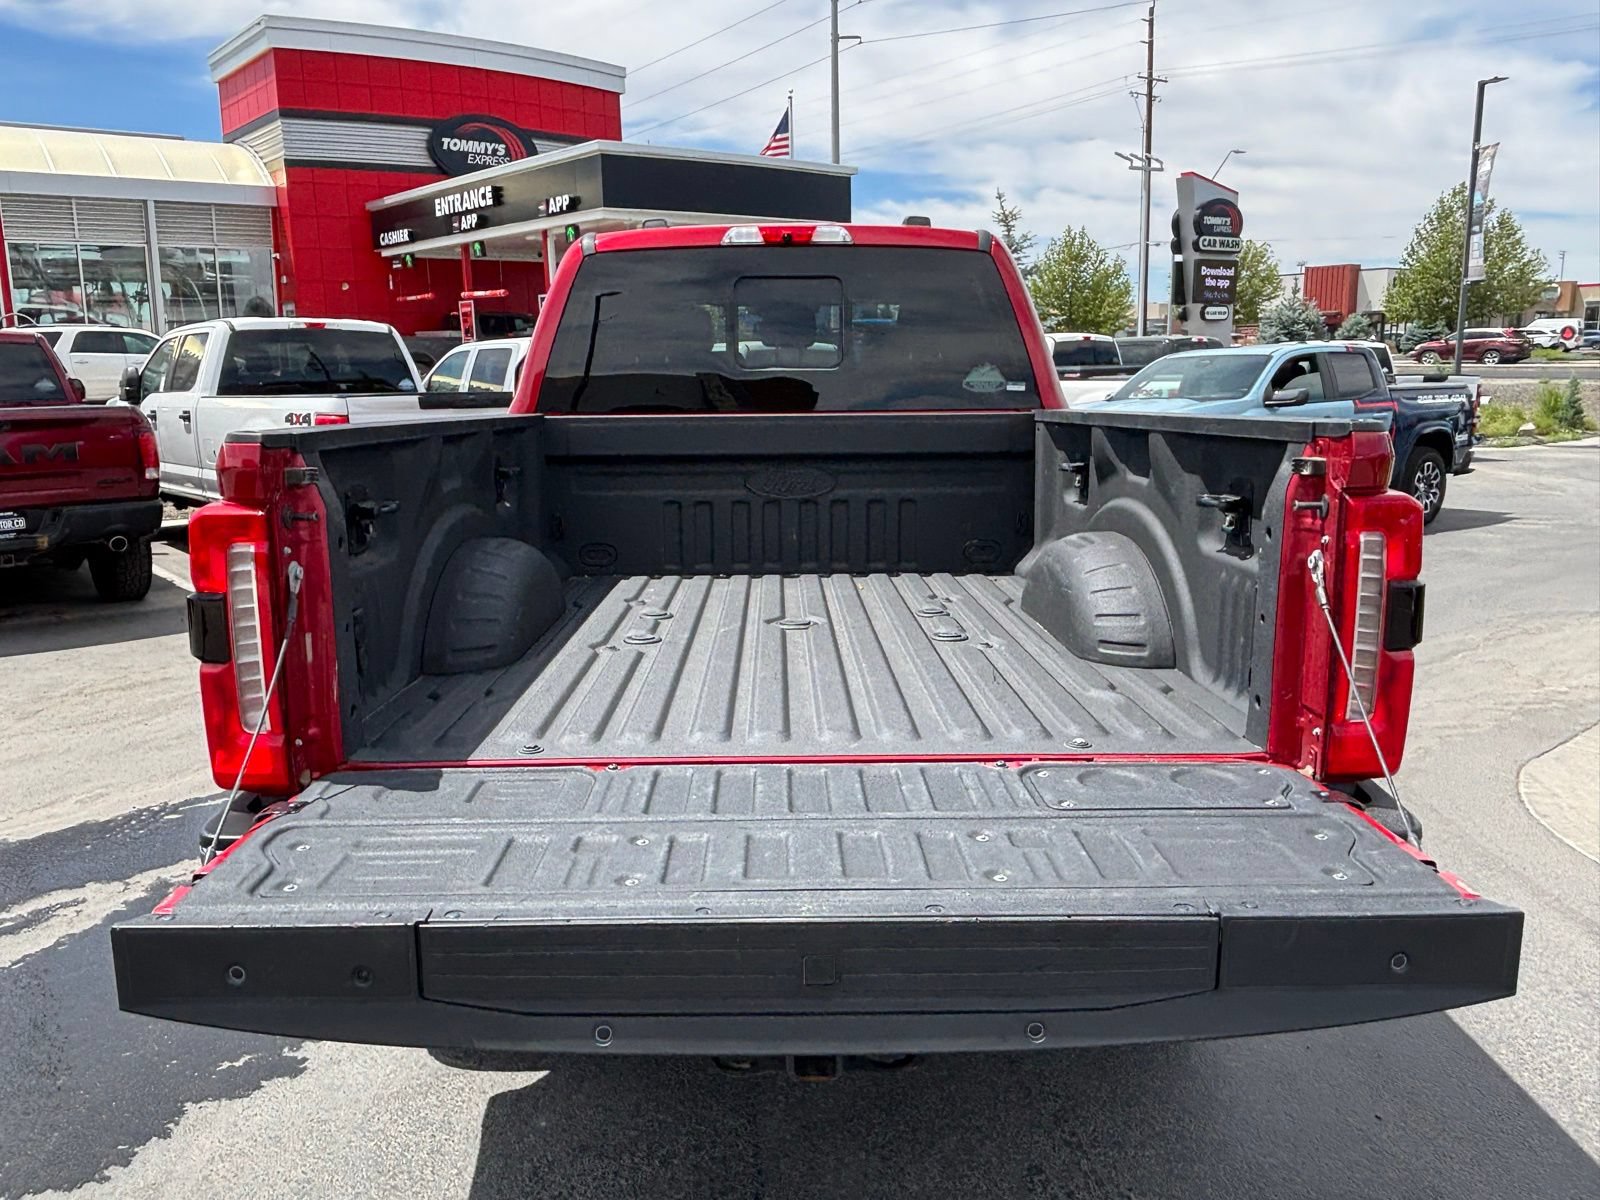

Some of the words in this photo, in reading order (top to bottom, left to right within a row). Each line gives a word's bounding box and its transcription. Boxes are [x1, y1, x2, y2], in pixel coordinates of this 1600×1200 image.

[442, 137, 506, 156] TOMMY'S
[434, 185, 493, 217] ENTRANCE
[548, 194, 570, 214] APP
[461, 213, 478, 231] APP
[380, 229, 409, 246] CASHIER
[1202, 238, 1217, 248] CAR
[1218, 239, 1240, 248] WASH
[1201, 266, 1235, 276] Download
[1205, 277, 1216, 286] the
[1217, 279, 1230, 289] app
